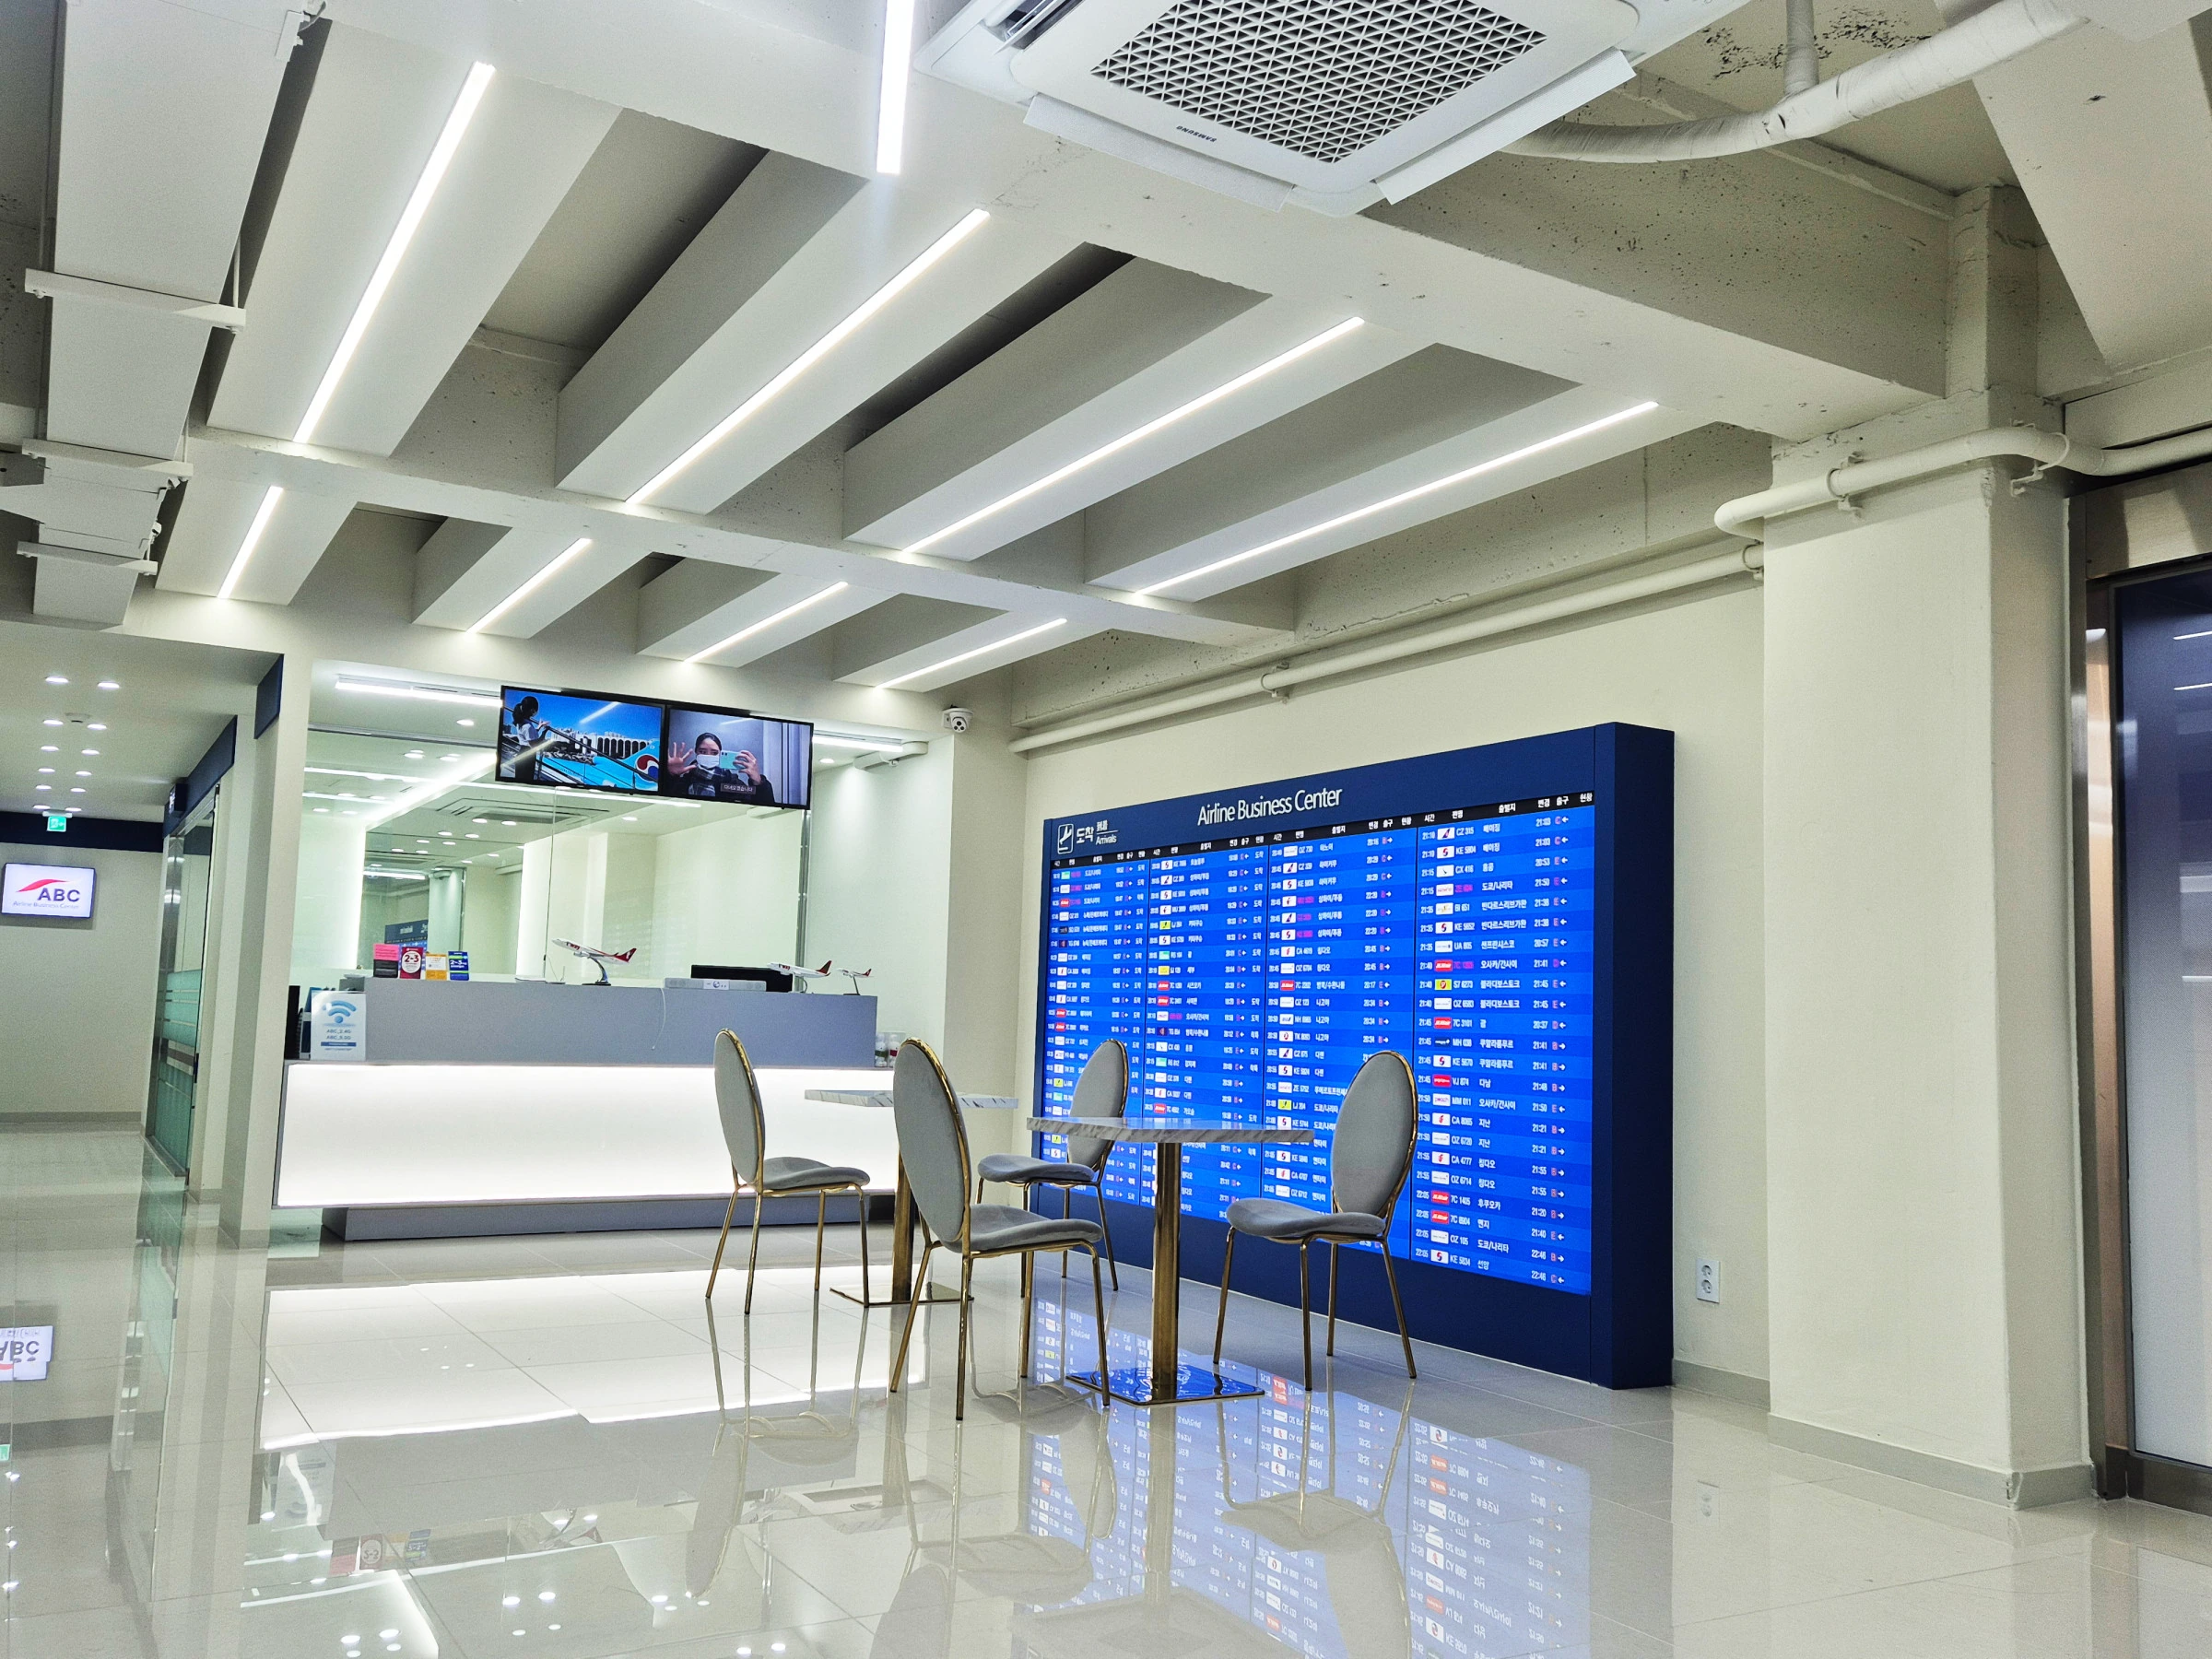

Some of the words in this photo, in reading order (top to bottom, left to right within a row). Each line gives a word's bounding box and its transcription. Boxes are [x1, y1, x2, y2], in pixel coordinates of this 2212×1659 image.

[1176, 126, 1217, 142] SAMSUNG
[1197, 803, 1235, 826] Airline
[1237, 795, 1293, 820] Business
[1294, 787, 1343, 811] Center
[1424, 813, 1436, 823] 시간
[1556, 795, 1570, 806] 출구
[1483, 823, 1500, 833] 베이징
[1535, 817, 1551, 827] 21:03
[1077, 827, 1094, 843] 도착
[1096, 834, 1117, 845] Arrivals
[1482, 842, 1500, 853] 베이징
[1535, 837, 1551, 847] 21:03
[1535, 857, 1551, 867] 20:53
[1481, 880, 1513, 891] 도쿄/나리타
[1535, 877, 1550, 888] 21:50
[38, 888, 80, 902] ABC
[1534, 898, 1550, 908] 21:38
[1534, 918, 1549, 927] 21:38
[1534, 938, 1549, 947] 20:57
[1480, 959, 1518, 970] 오사카/간사이
[1534, 959, 1548, 968] 21:41
[1533, 979, 1549, 988] 21:45
[1533, 1000, 1549, 1009] 21:45
[1533, 1020, 1548, 1030] 20:37
[1533, 1041, 1547, 1050] 21:41
[1533, 1061, 1547, 1070] 21:41
[1478, 1078, 1491, 1088] 다낭
[1532, 1082, 1548, 1091] 21:48
[1478, 1098, 1516, 1111] 오사카/간사이
[1532, 1102, 1547, 1112] 21:50
[1478, 1118, 1491, 1128] 지난
[1532, 1123, 1547, 1133] 21:21
[1478, 1138, 1491, 1148] 지난
[1532, 1144, 1547, 1154] 21:21
[1478, 1158, 1496, 1169] 칭다오
[1531, 1165, 1547, 1175] 21:55
[1478, 1178, 1496, 1189] 칭다오
[1531, 1185, 1547, 1196] 21:55
[1477, 1198, 1501, 1211] 후쿠오카
[1531, 1206, 1547, 1218] 21:20
[1477, 1218, 1490, 1230] 옌지
[1531, 1228, 1547, 1239] 21:40
[1477, 1239, 1510, 1253] 도쿄/나리타
[1531, 1249, 1547, 1260] 22:46
[1477, 1260, 1489, 1271] 선양
[1531, 1270, 1547, 1281] 22:46
